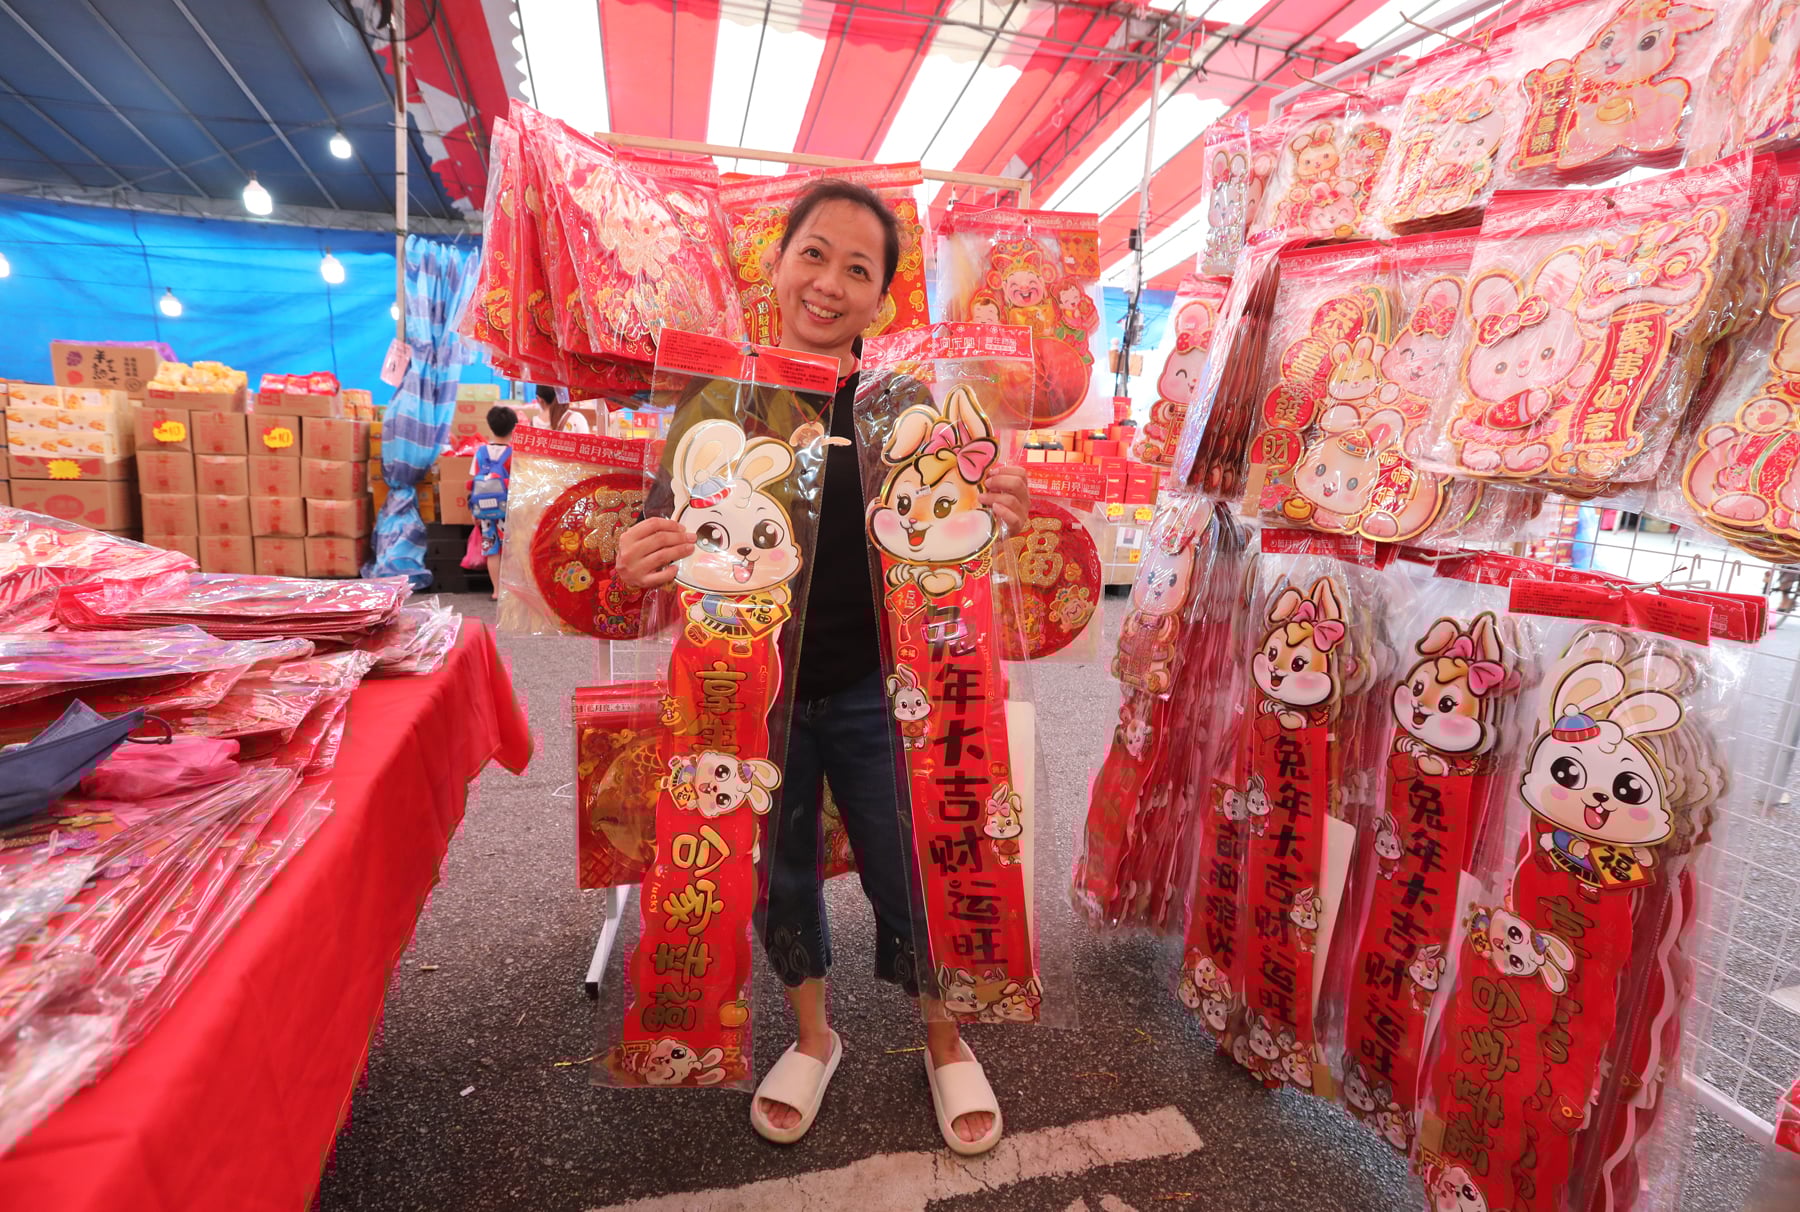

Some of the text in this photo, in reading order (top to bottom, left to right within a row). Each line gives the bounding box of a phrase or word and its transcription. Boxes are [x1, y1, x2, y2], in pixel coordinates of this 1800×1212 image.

[1531, 78, 1567, 154] 平安喜樂
[1579, 320, 1656, 441] 萬事如意
[512, 432, 548, 448] 蓝月亮
[579, 444, 614, 459] 蓝月亮
[1051, 479, 1082, 493] 蓝月亮
[745, 594, 774, 625] 福
[896, 589, 917, 609] 福
[922, 604, 1009, 965] 兔年大吉财运旺
[1598, 844, 1636, 882] 福
[649, 881, 662, 914] lucky
[642, 825, 731, 1033] 合家幸福
